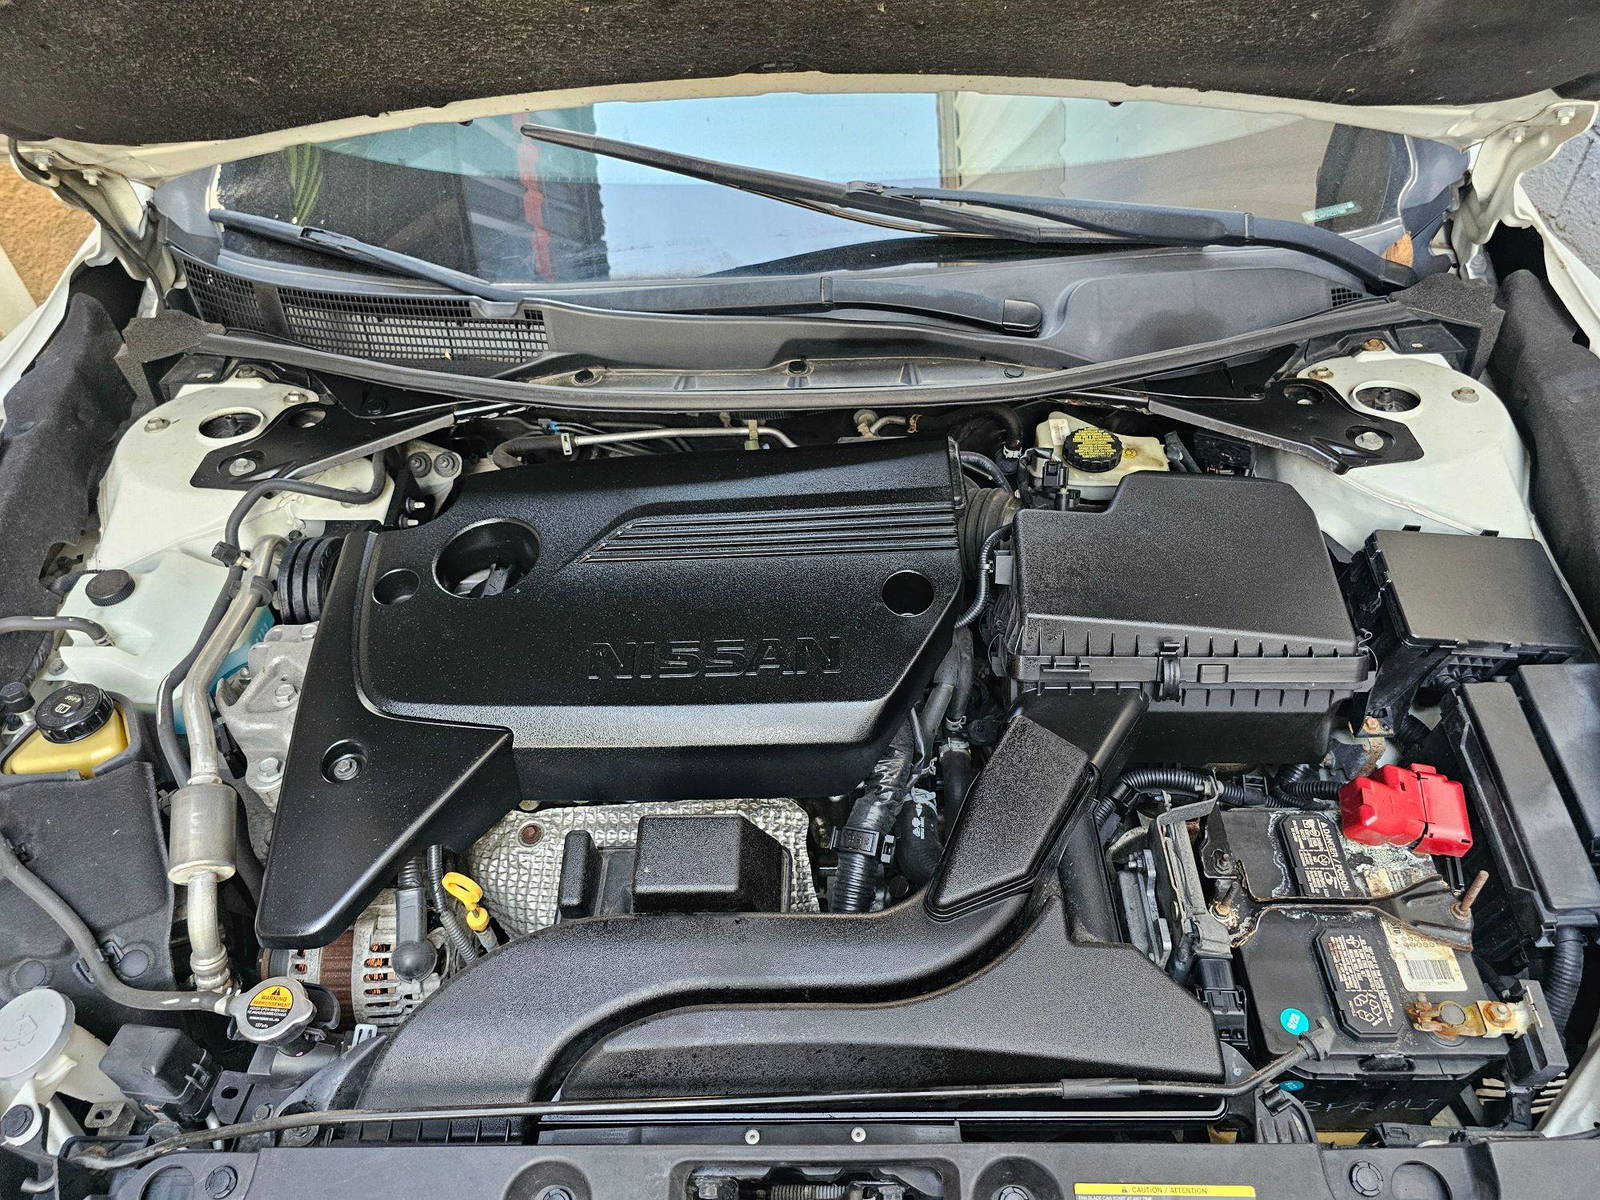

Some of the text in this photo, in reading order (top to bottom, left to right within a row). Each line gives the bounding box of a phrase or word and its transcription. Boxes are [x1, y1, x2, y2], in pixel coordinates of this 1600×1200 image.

[588, 636, 842, 679] NISSAN
[1323, 828, 1339, 858] DANGER
[1334, 864, 1351, 891] POISON
